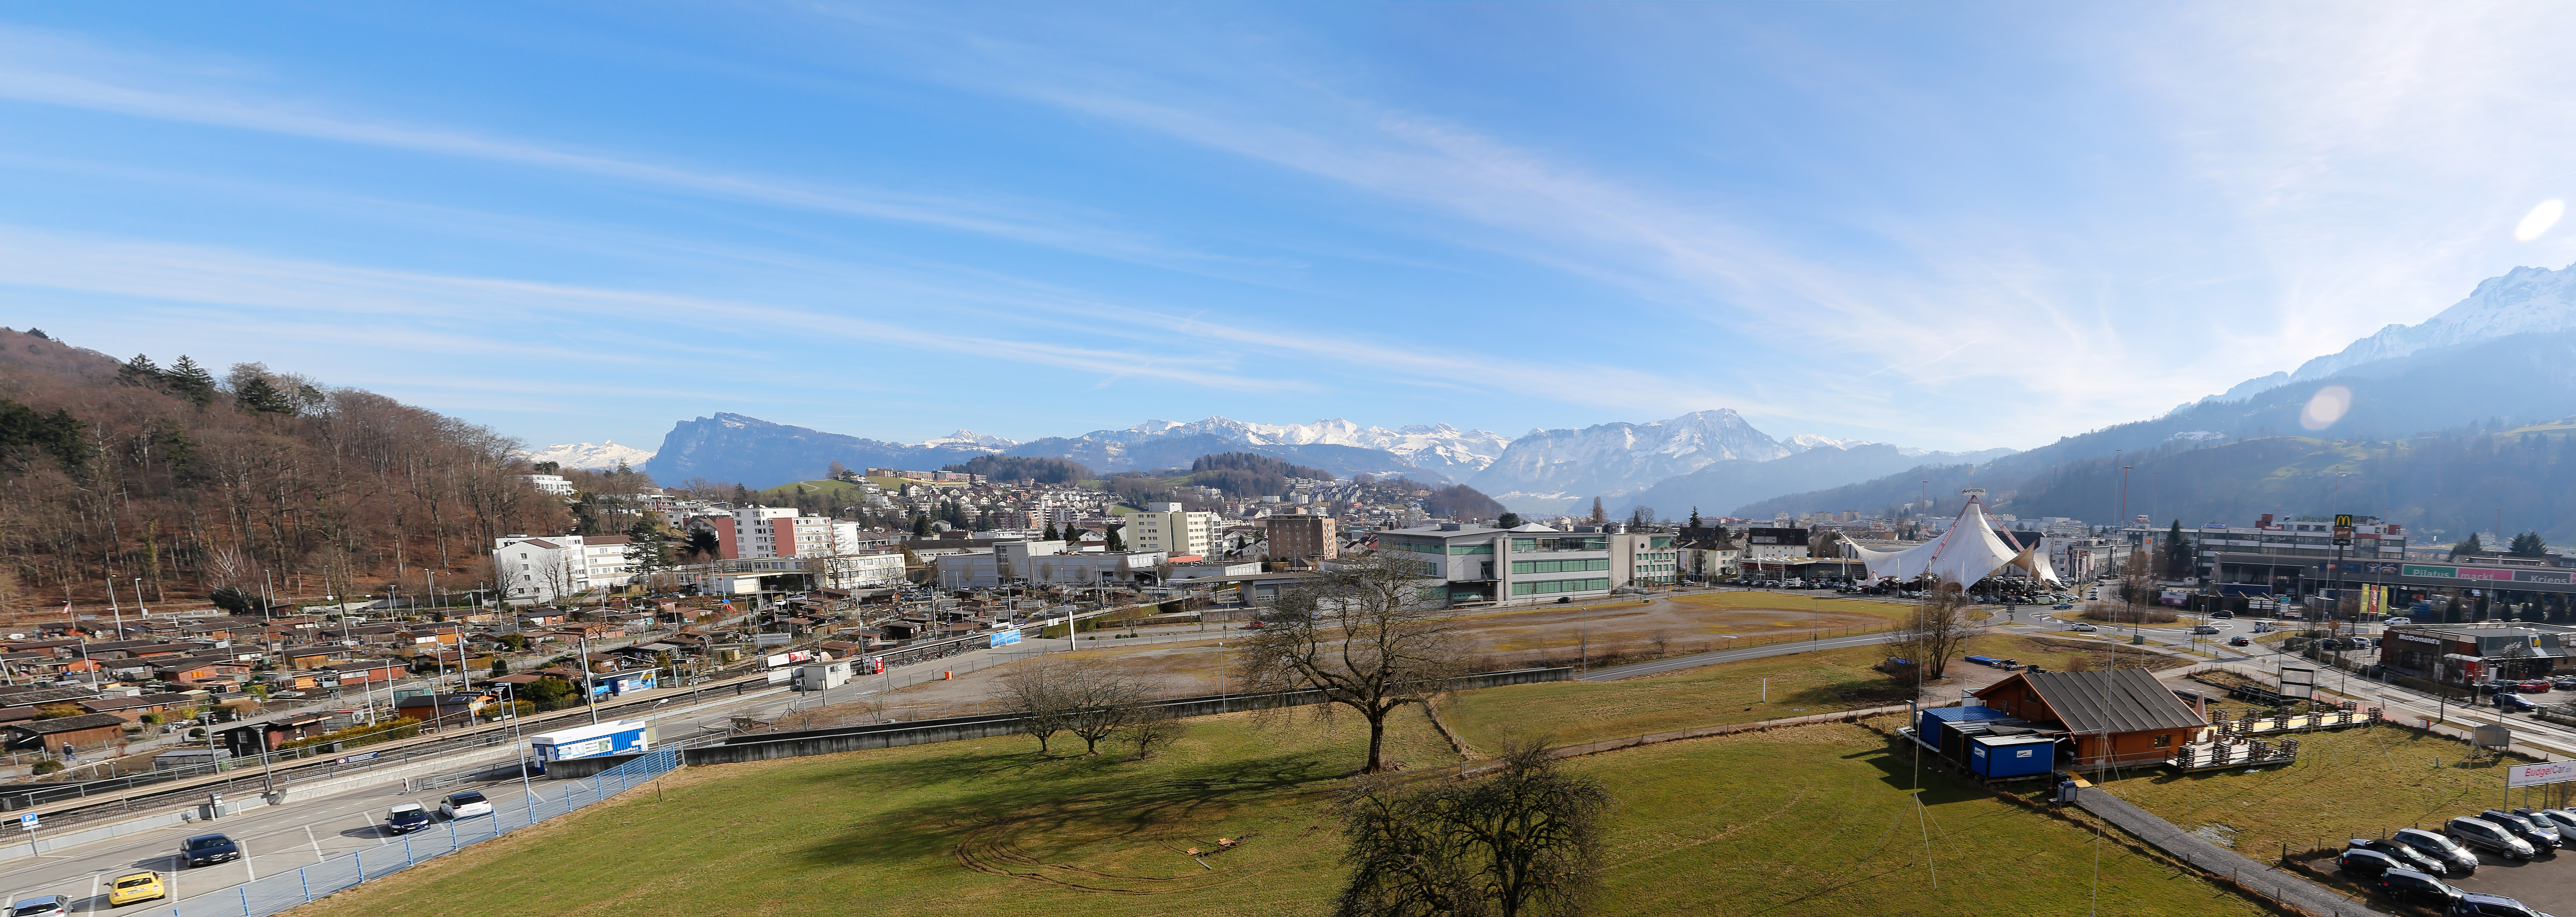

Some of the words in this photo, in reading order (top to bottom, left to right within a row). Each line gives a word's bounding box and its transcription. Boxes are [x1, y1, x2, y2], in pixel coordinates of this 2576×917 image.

[1934, 545, 1943, 557] SOFORT
[1942, 526, 1955, 544] BARANKAUF
[2413, 569, 2449, 577] Pilatus
[2531, 575, 2567, 584] Kriens
[2399, 634, 2440, 645] McDonald's
[2525, 765, 2571, 777] BudgetCar.ch
